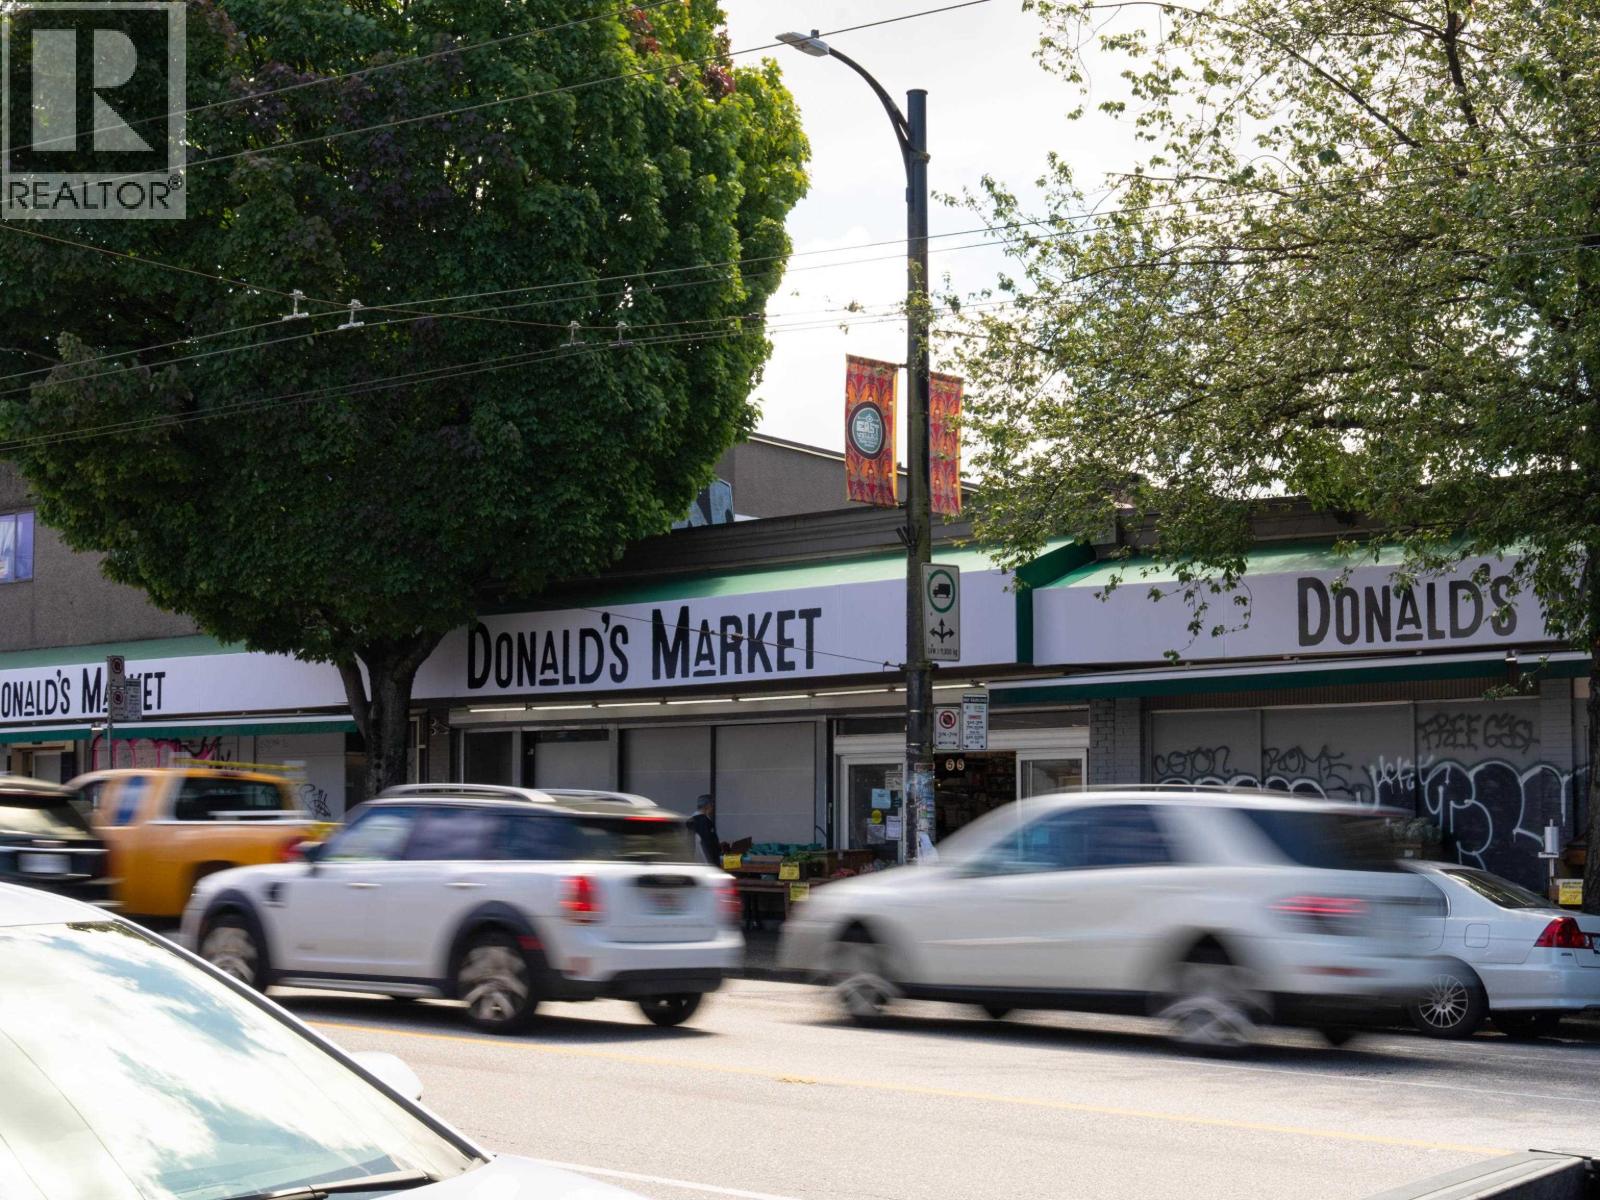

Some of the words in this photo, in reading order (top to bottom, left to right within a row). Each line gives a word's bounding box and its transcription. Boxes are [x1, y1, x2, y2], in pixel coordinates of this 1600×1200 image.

[467, 611, 629, 689] DONALD'S
[651, 605, 822, 680] MARKET
[1297, 563, 1518, 647] DONALD'S
[0, 669, 71, 718] ONALD'S
[82, 667, 166, 714] MET
